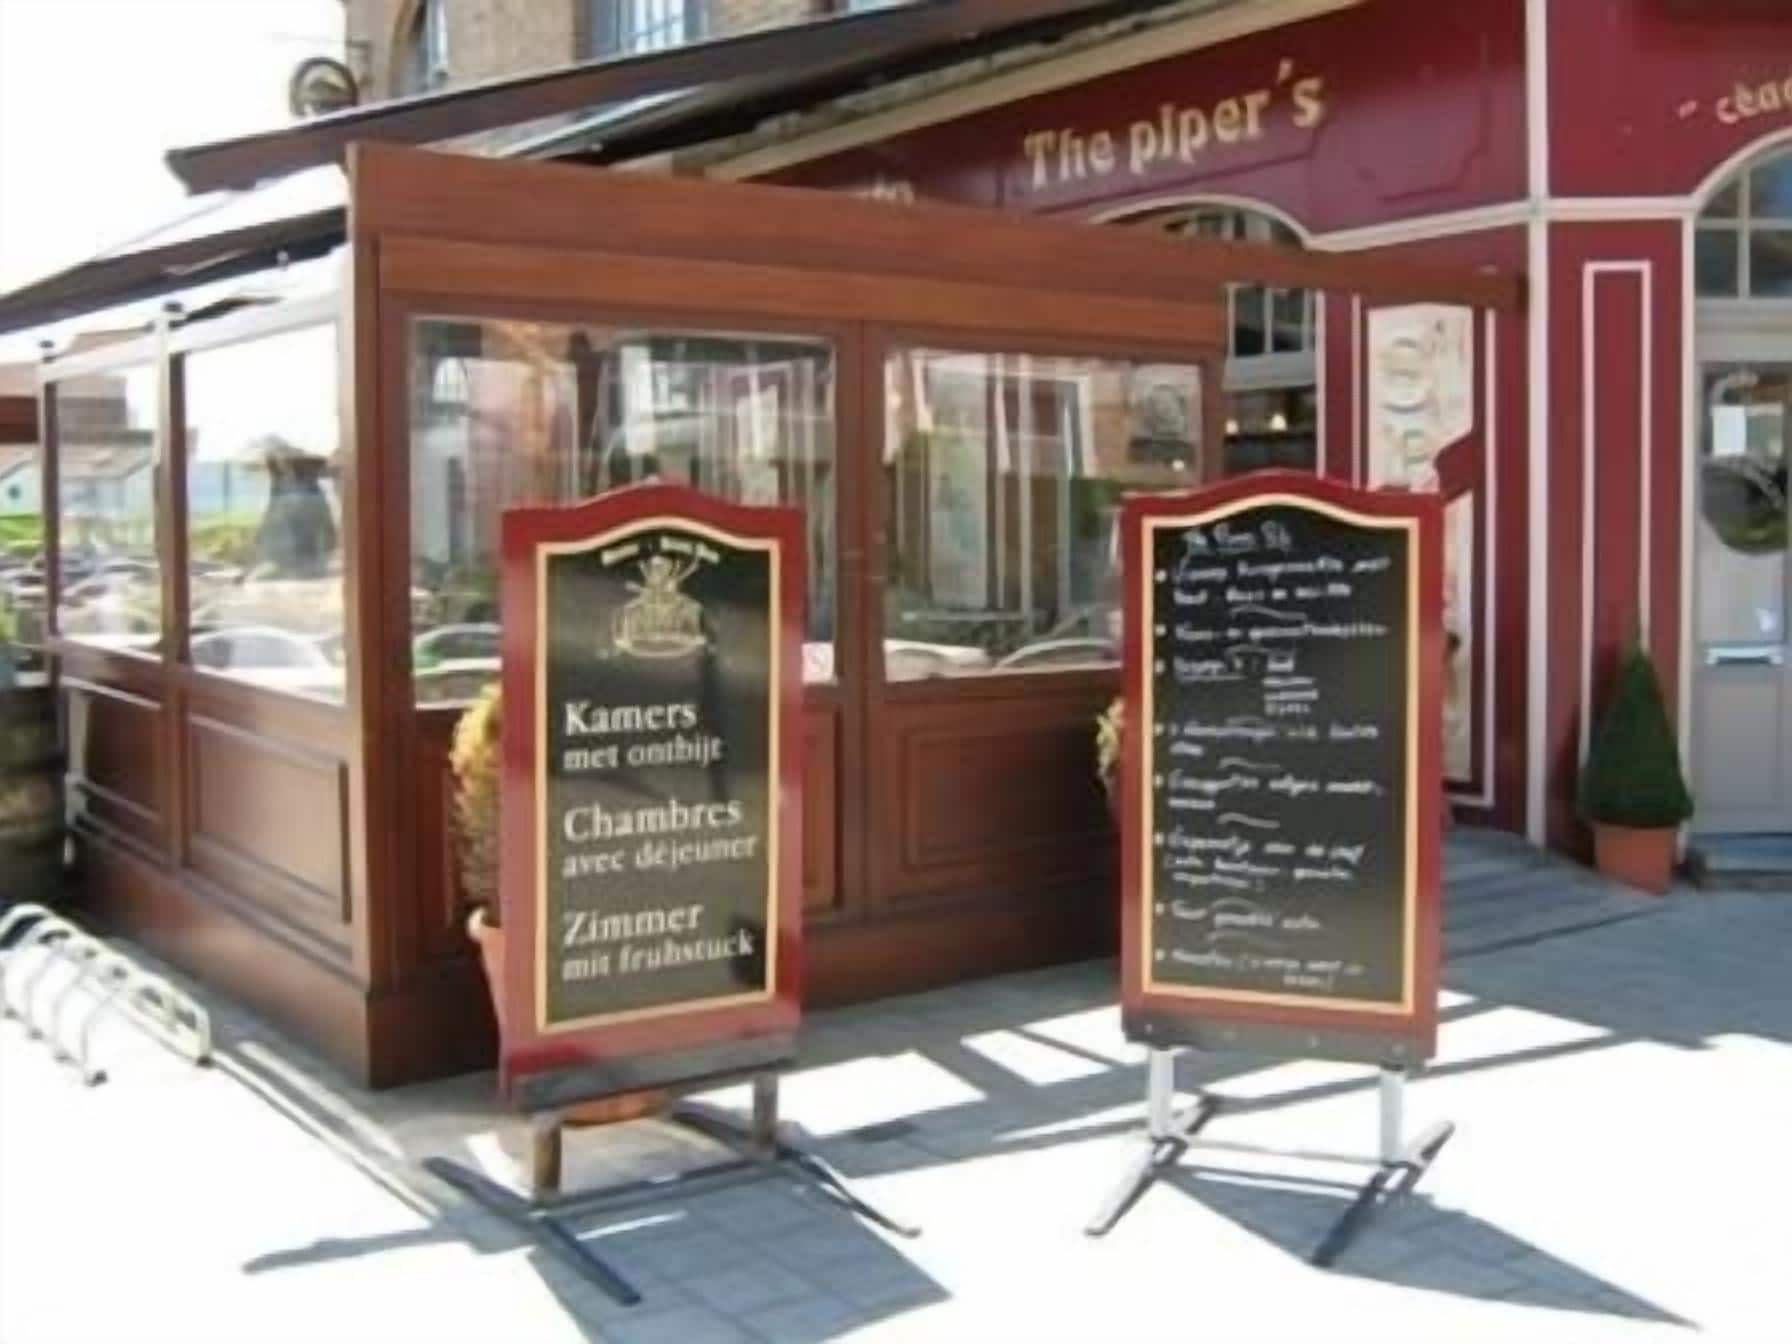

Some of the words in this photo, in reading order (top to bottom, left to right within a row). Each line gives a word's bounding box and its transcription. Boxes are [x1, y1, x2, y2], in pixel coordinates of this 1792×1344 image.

[1023, 127, 1117, 192] The
[564, 700, 698, 736] Kamers
[563, 741, 620, 770] met
[627, 733, 723, 767] ontbijt
[563, 797, 743, 842] Chambres
[562, 849, 624, 879] avec
[563, 904, 704, 949] Zimmer
[562, 952, 611, 982] mit
